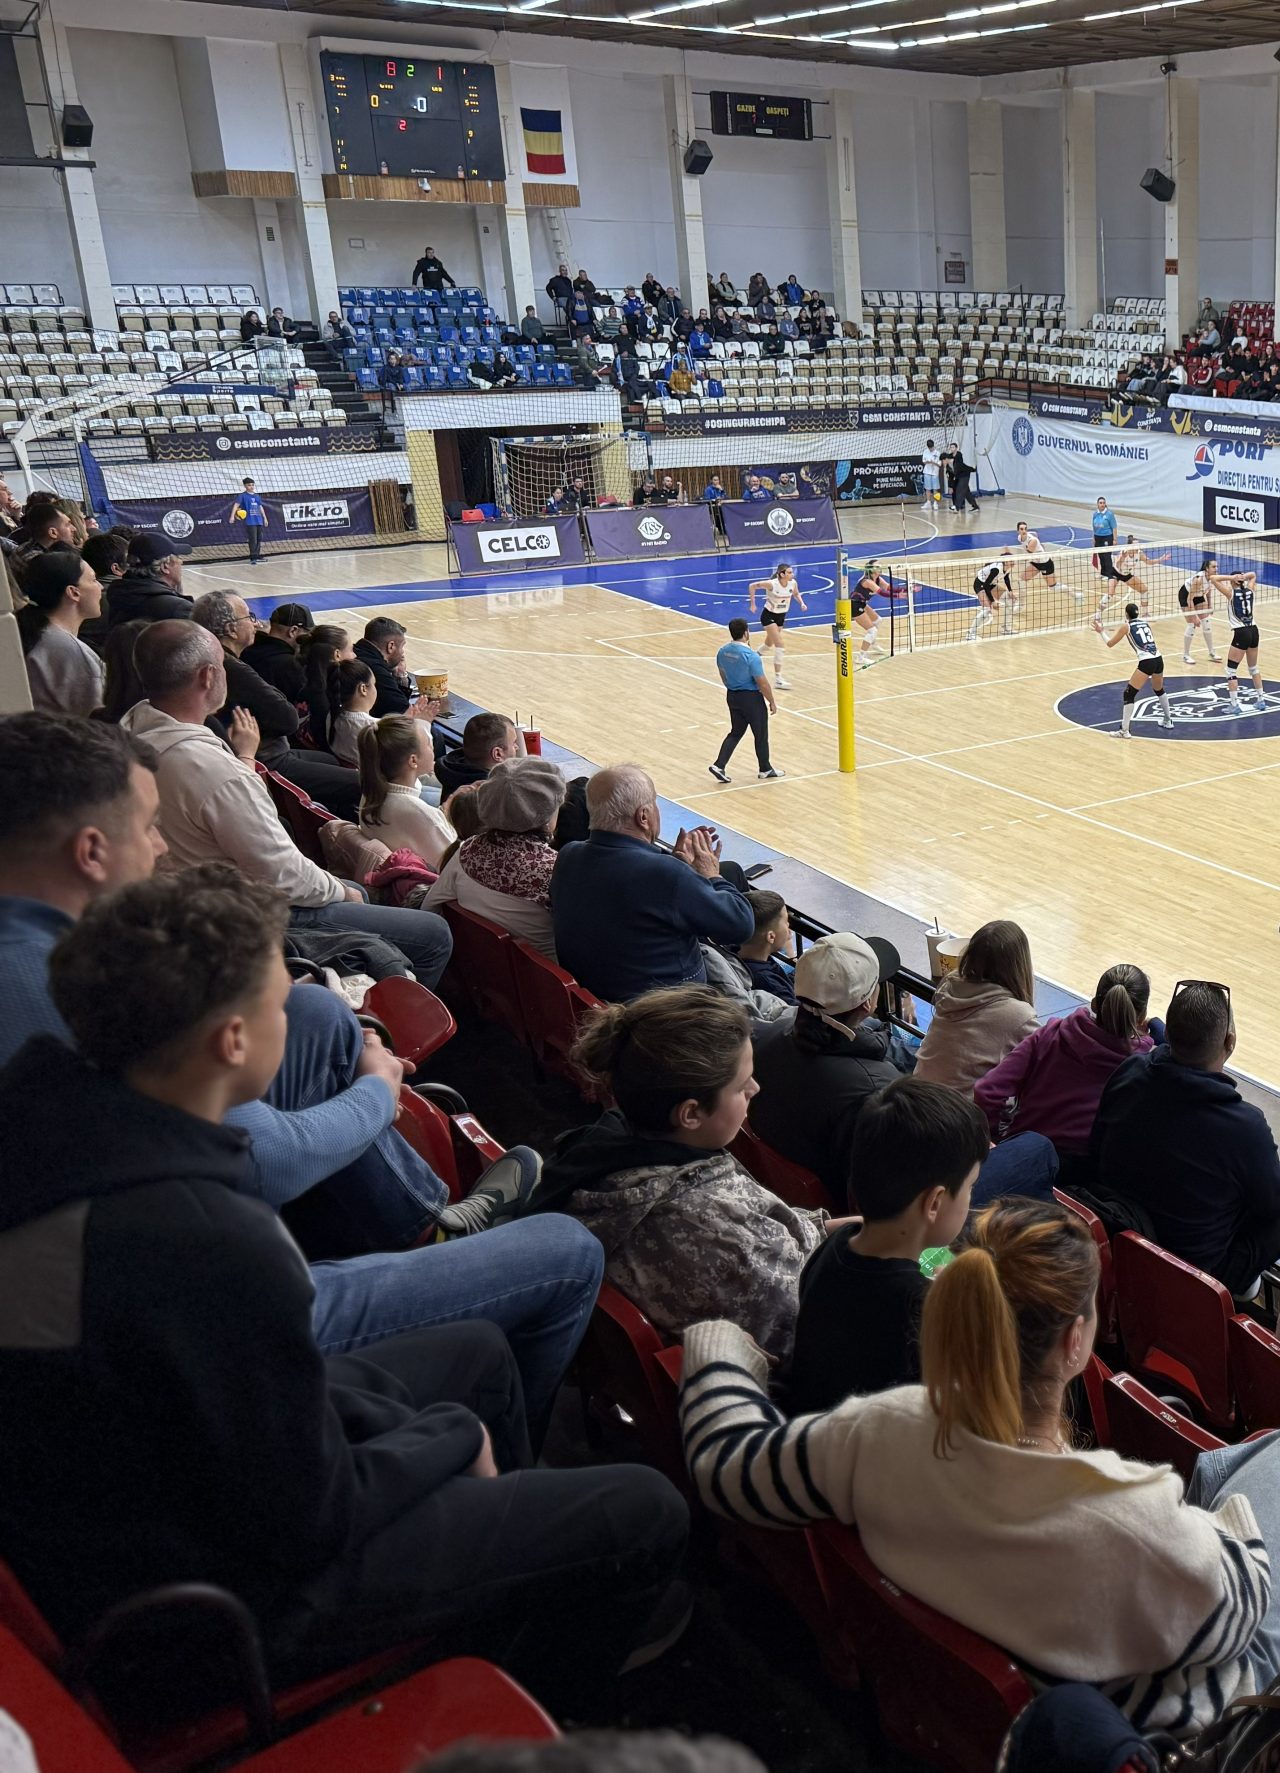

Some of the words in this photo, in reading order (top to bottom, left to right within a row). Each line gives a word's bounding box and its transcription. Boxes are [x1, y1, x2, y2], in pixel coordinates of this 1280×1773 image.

[406, 64, 415, 77] 2
[370, 95, 379, 108] 0
[862, 413, 882, 423] CSM
[1213, 423, 1261, 436] csmconstanta
[234, 436, 320, 448] csmconstanta
[1038, 434, 1093, 454] GUVERNUL
[1095, 444, 1149, 460] ROMÂNIEI
[1218, 470, 1246, 491] DIRECȚIA
[1247, 474, 1274, 492] PENTRU
[290, 506, 342, 518] rik.ro
[1136, 627, 1153, 643] 13
